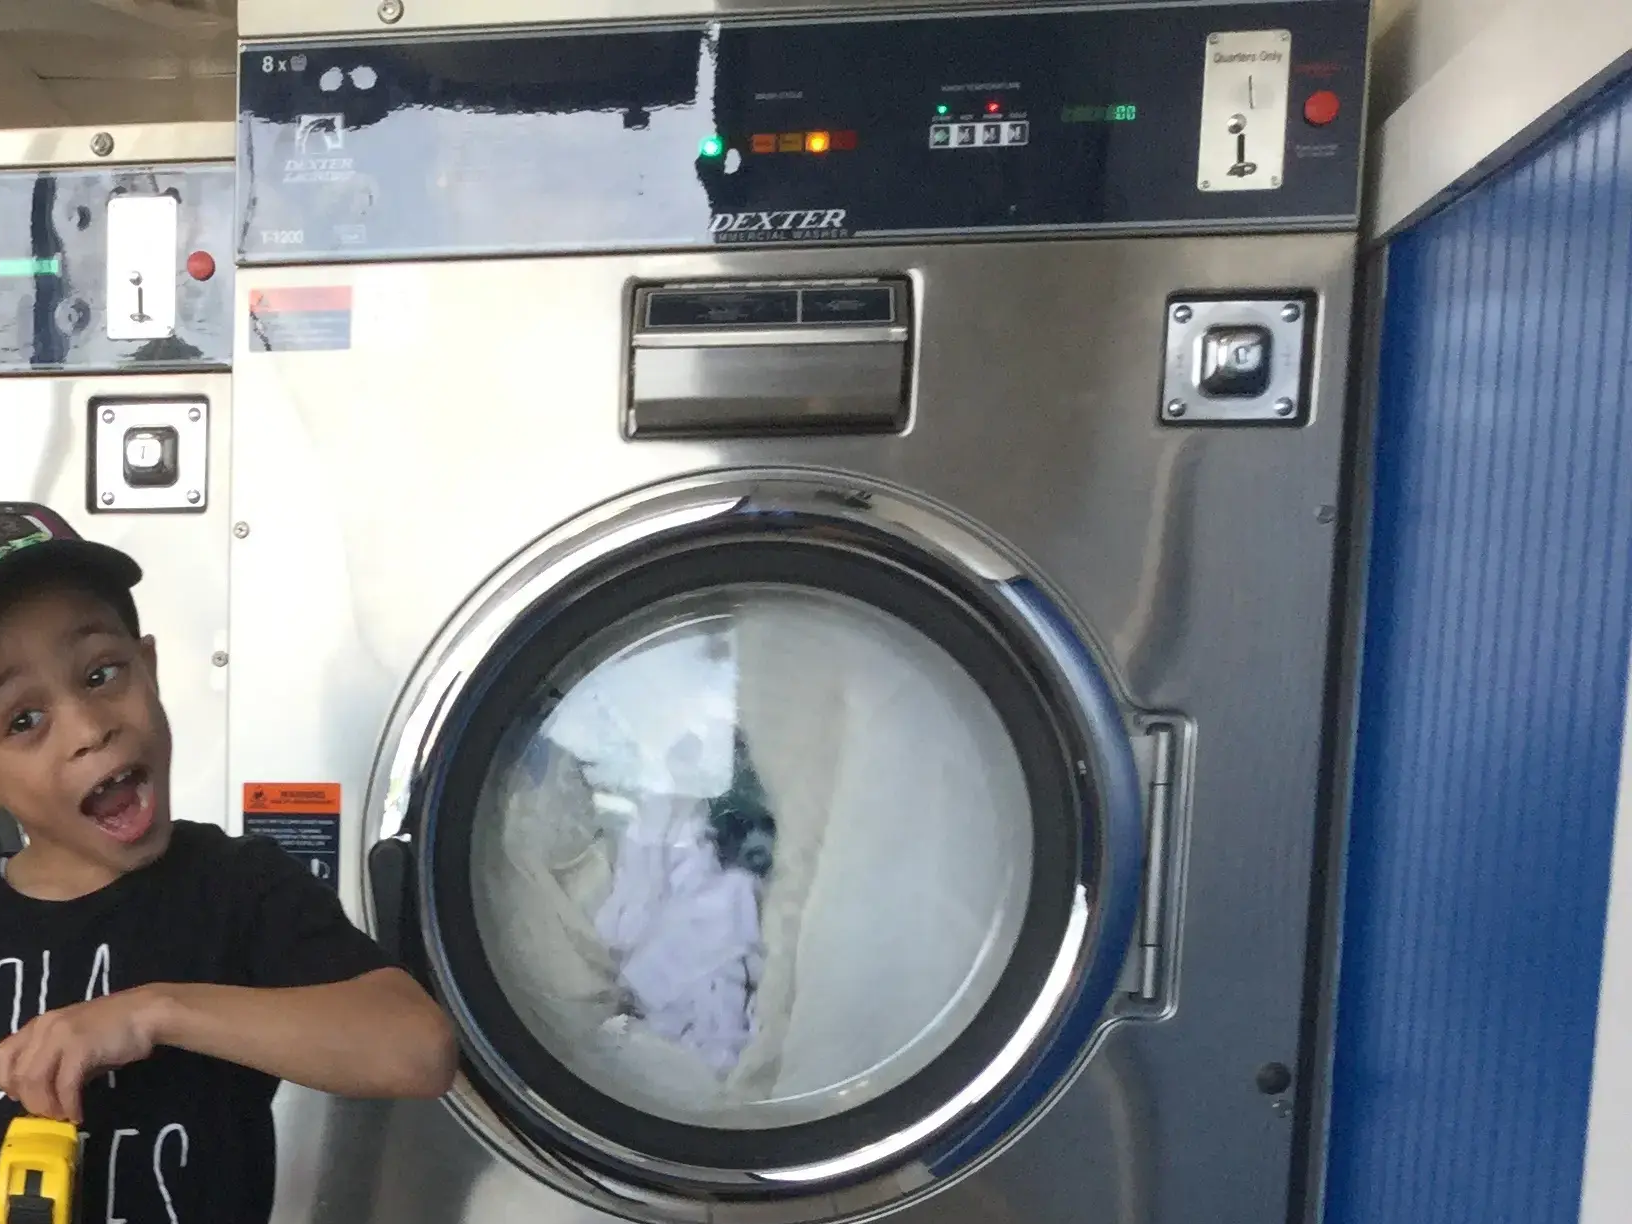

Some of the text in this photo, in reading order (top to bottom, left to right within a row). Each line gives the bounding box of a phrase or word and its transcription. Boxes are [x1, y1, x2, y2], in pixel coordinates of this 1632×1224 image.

[262, 55, 274, 73] 8
[1213, 49, 1283, 64] Quarters Only
[708, 209, 847, 232] DEXTER
[714, 228, 848, 243] MMERCIAL WASHER
